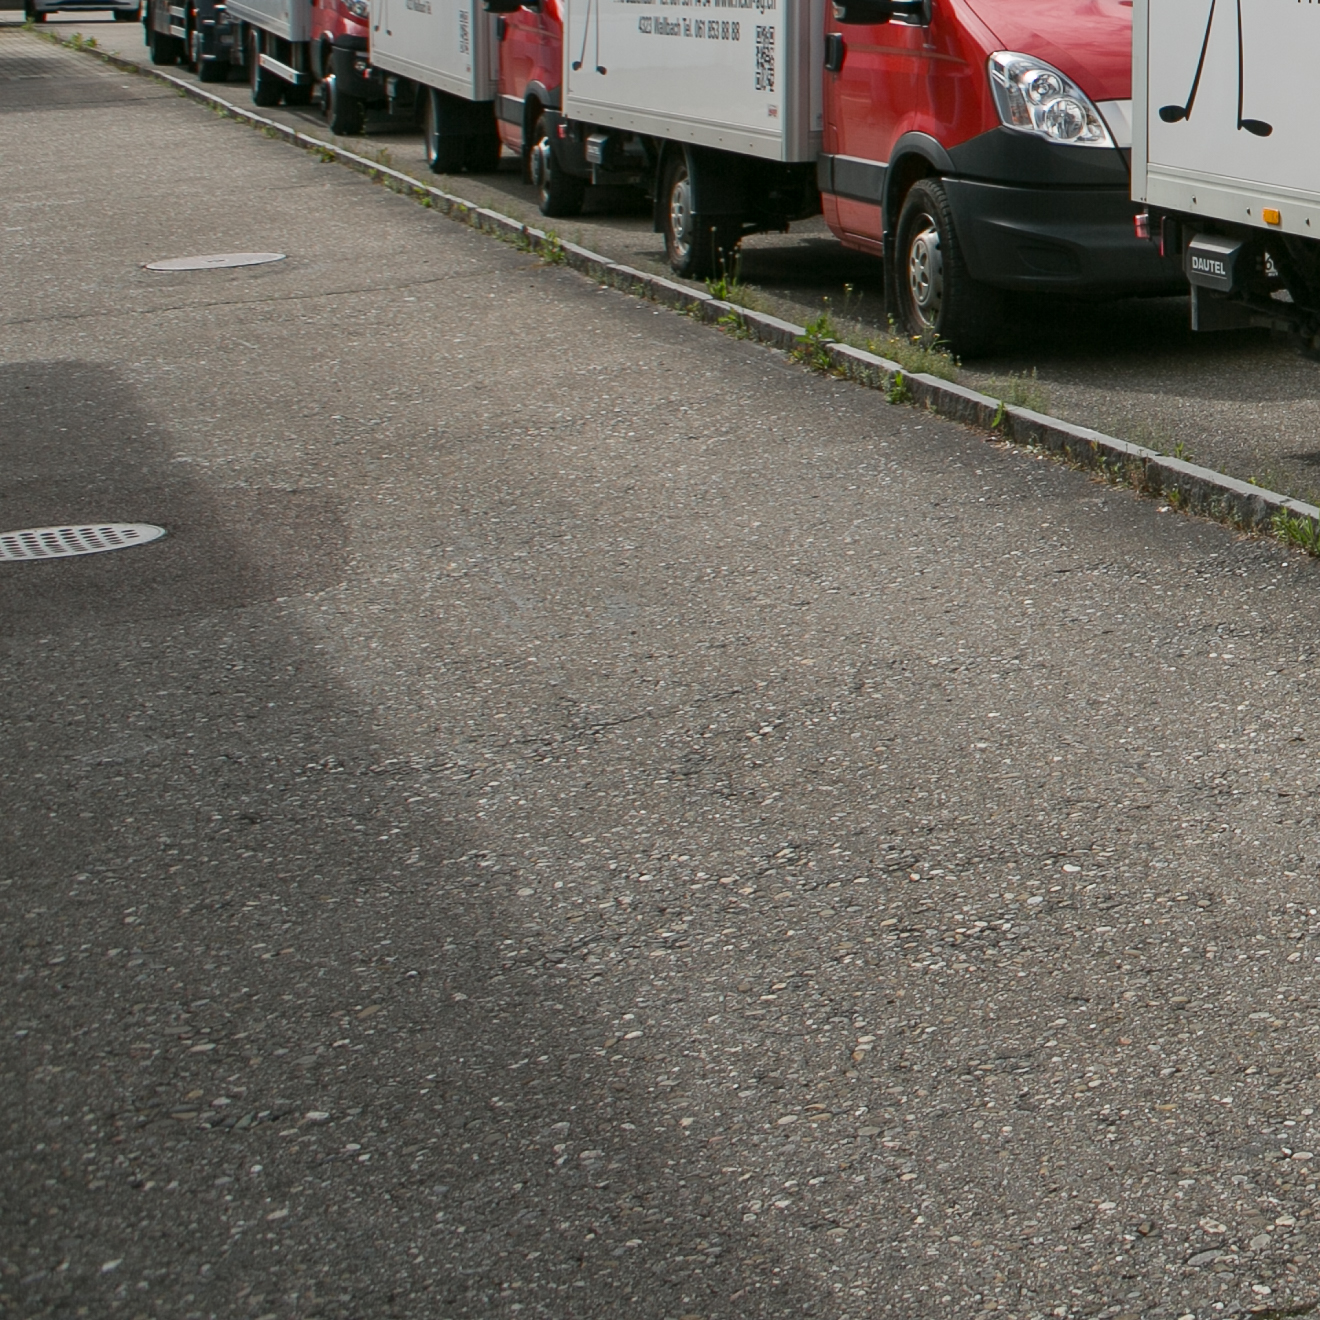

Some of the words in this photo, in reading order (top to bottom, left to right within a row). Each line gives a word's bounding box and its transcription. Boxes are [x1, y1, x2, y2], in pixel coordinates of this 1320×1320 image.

[721, 21, 731, 41] 88
[731, 21, 740, 42] 88
[1192, 256, 1226, 276] DAUTEL
